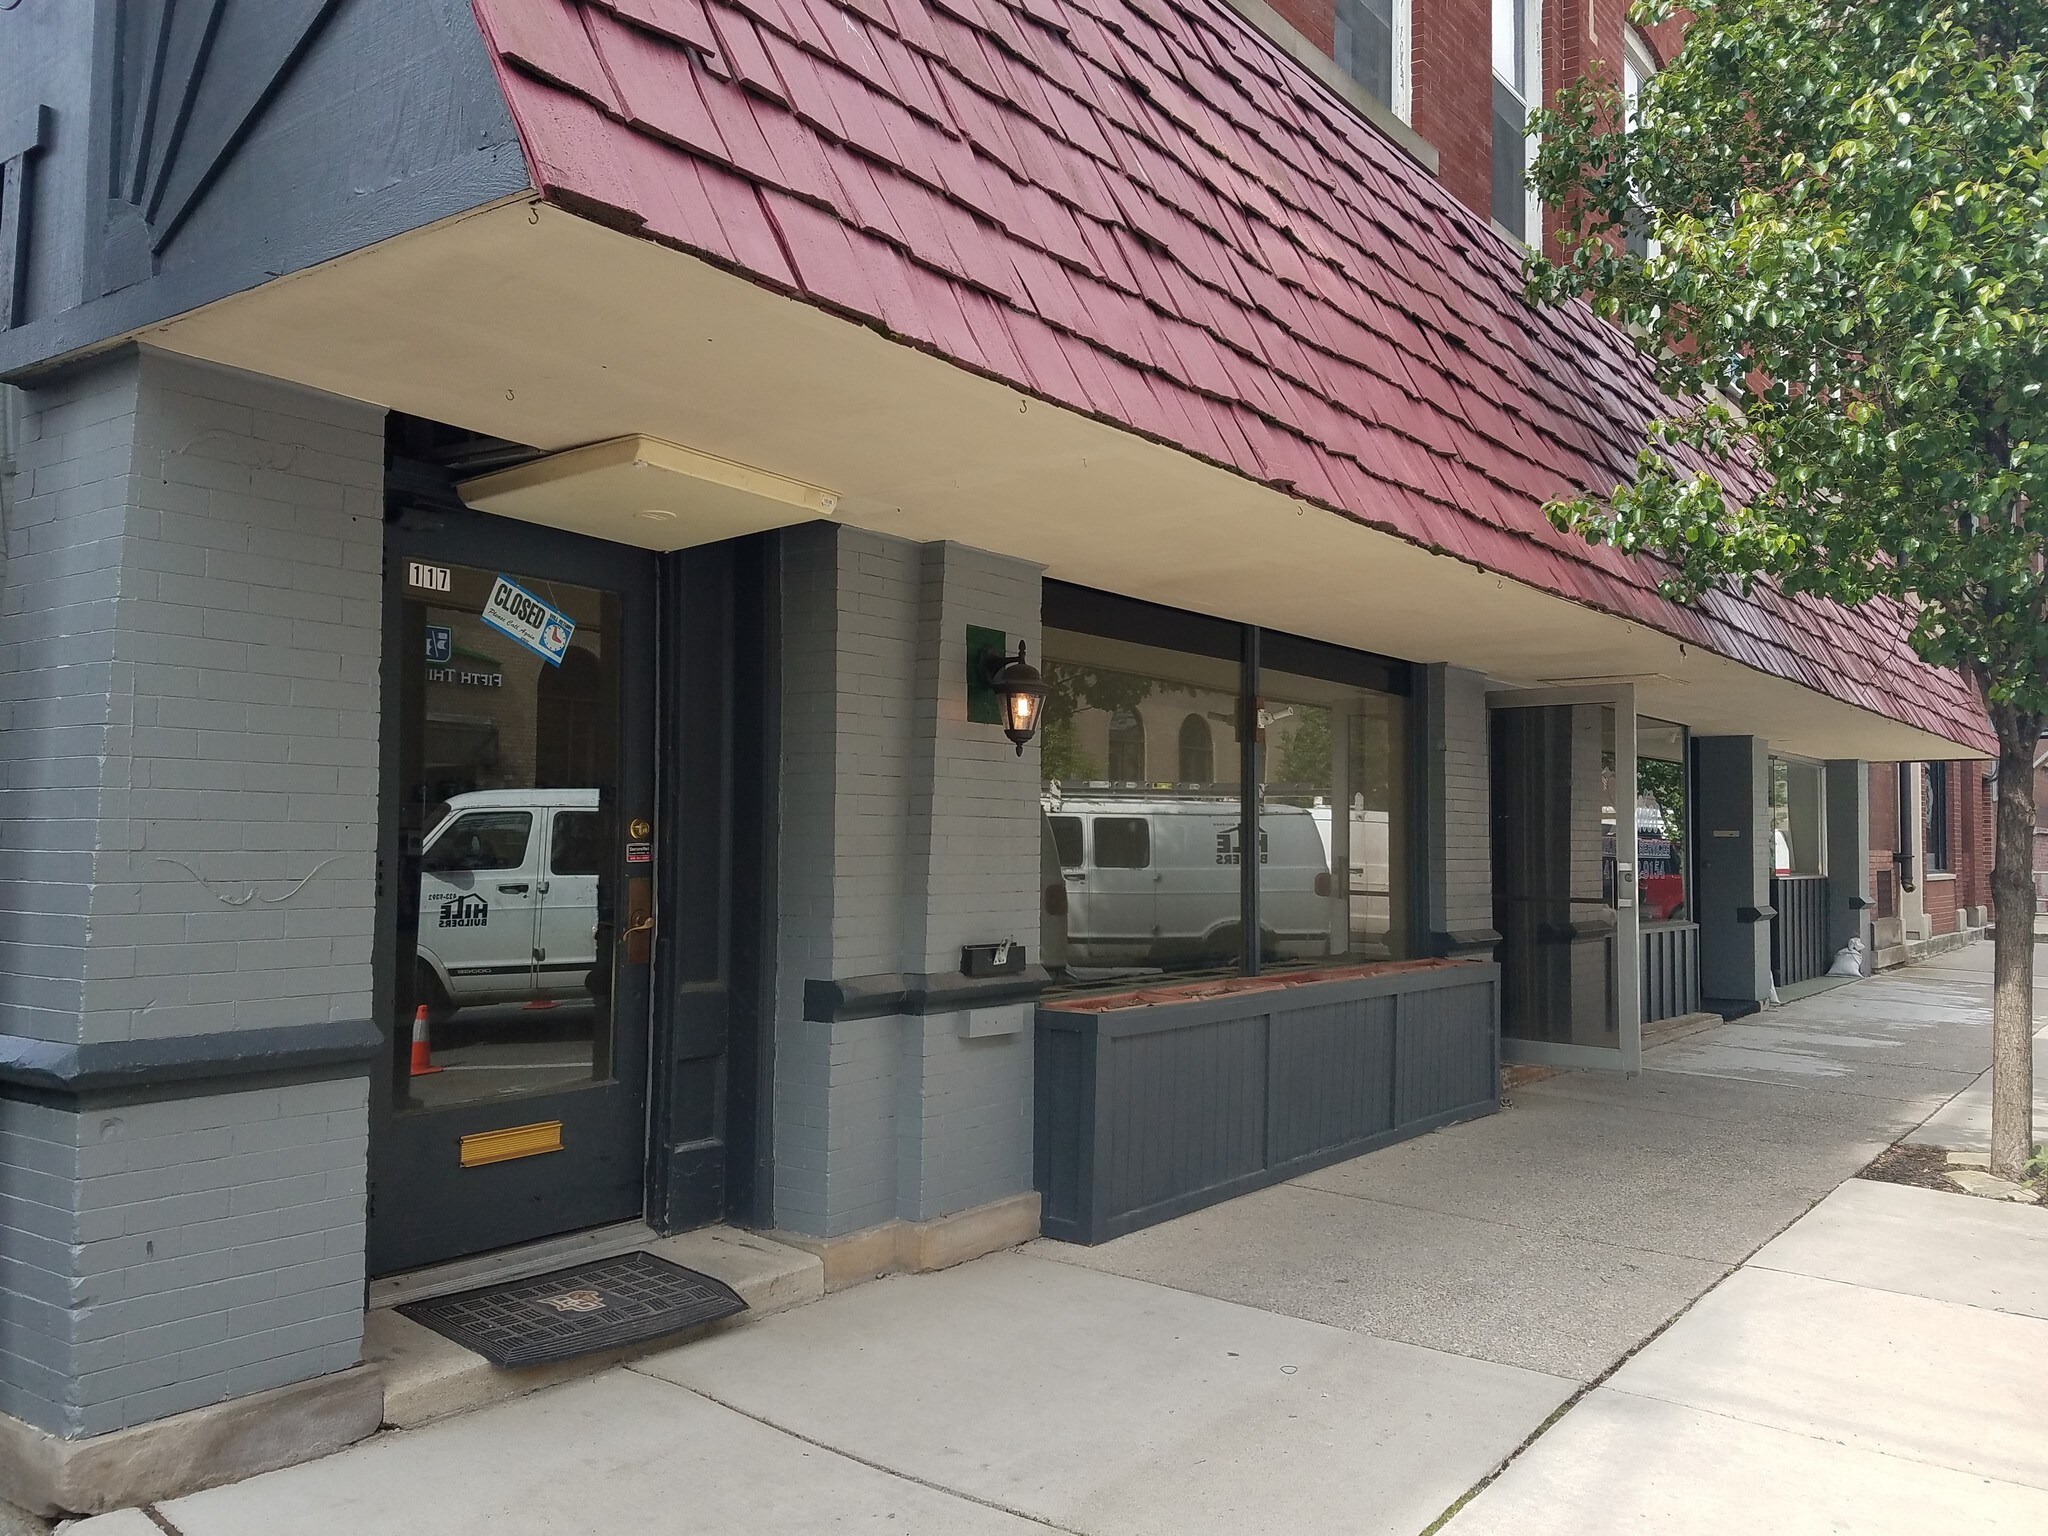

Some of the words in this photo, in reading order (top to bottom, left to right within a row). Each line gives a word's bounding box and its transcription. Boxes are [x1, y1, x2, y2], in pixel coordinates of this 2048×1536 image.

[413, 565, 447, 589] 117
[494, 583, 546, 630] CLOSED
[488, 607, 506, 622] Please
[506, 620, 520, 630] Call
[518, 628, 536, 641] Again
